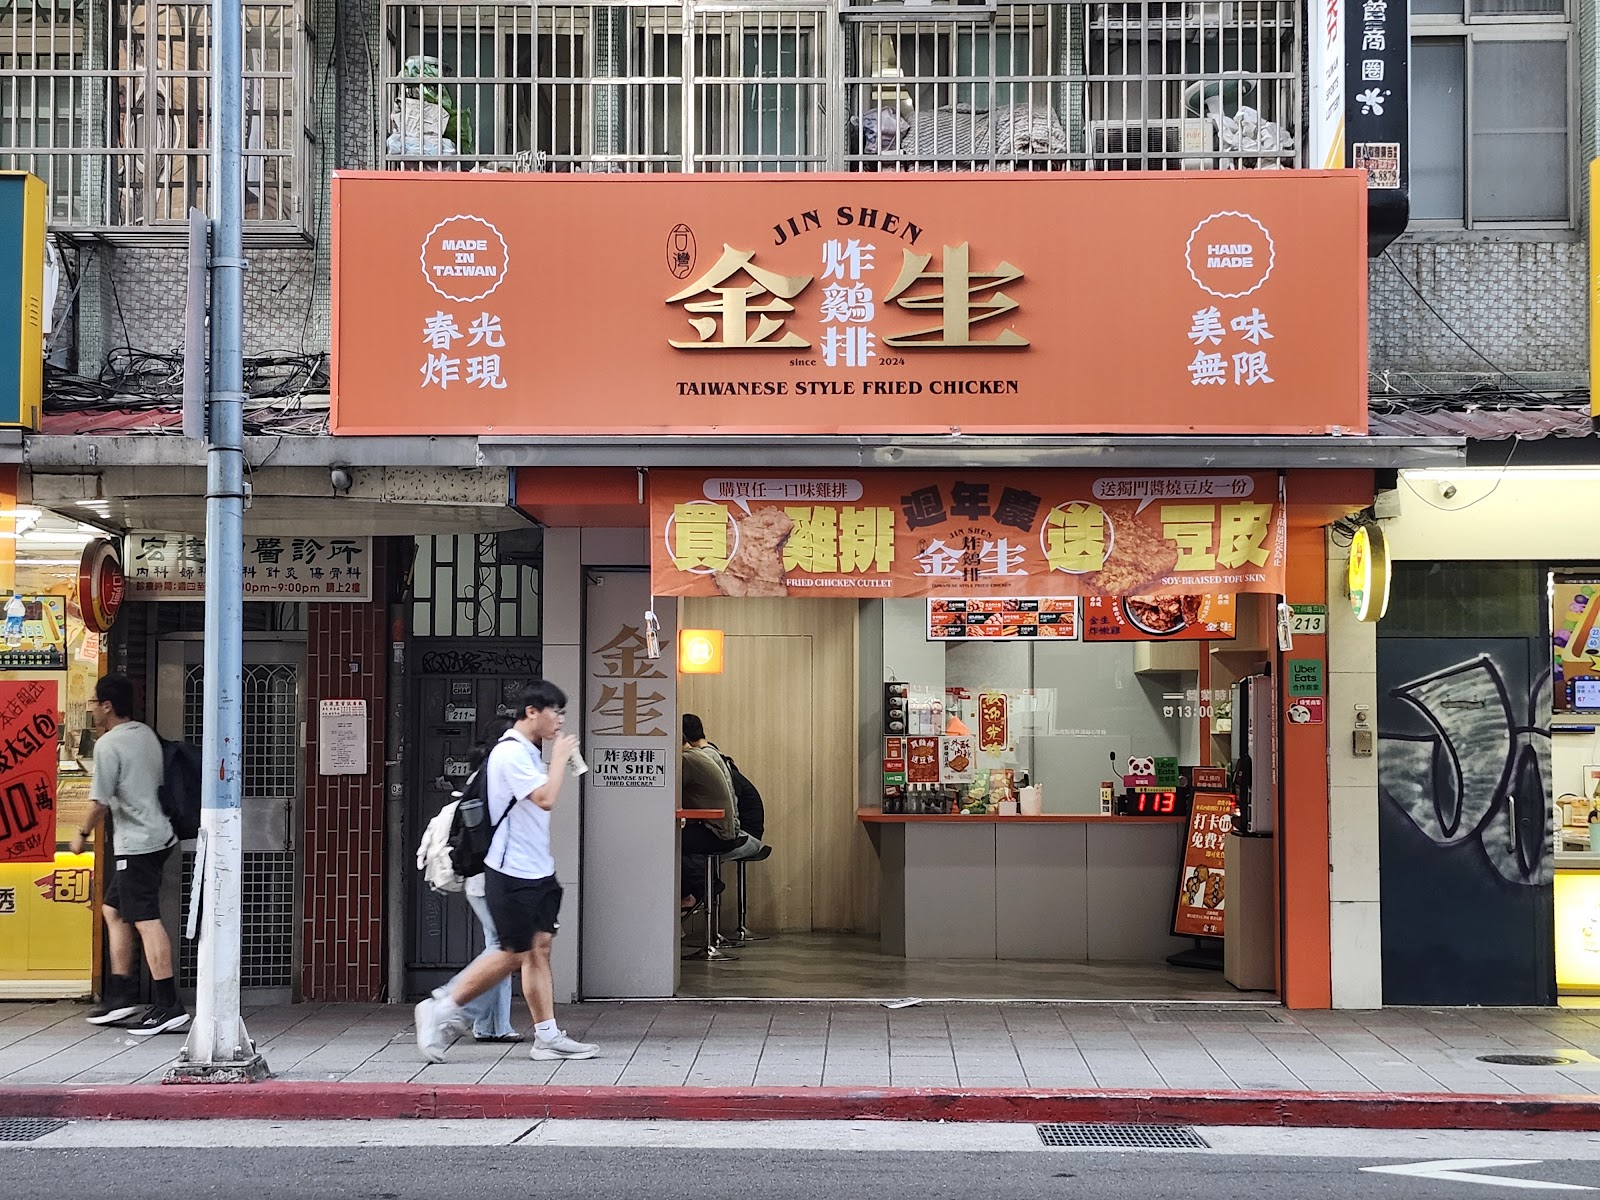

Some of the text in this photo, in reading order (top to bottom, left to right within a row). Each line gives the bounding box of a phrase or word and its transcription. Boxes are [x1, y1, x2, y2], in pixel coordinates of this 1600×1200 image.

[774, 206, 924, 246] JIN SHEN
[442, 239, 487, 251] MADE
[1207, 244, 1253, 255] HAND
[454, 252, 475, 264] IN
[1207, 256, 1254, 268] MADE
[432, 265, 497, 277] TAIWAN
[422, 310, 507, 351] 春光
[1187, 305, 1275, 346] 美味
[789, 357, 906, 367] since 2024
[1187, 349, 1275, 386] 無限
[419, 352, 508, 390] 炸現
[676, 379, 1019, 396] TAIWANESE STYLE FRIED CHICKEN
[718, 481, 849, 499] 購買任一口味雞排
[1100, 478, 1247, 497] 送獨門醬燒豆皮一份
[901, 480, 1042, 534] 週年慶
[672, 503, 895, 574] 買 雞排
[950, 527, 993, 540] JIN SHEN
[1048, 500, 1273, 573] 送 豆皮
[135, 537, 363, 565] 宏達醫診所
[912, 537, 1029, 576] 金生
[135, 566, 169, 579] 內科
[265, 566, 298, 580] 針灸
[1162, 575, 1222, 586] SOY-BRAISED
[1245, 573, 1266, 583] SKIN
[786, 578, 893, 589] FRIED CHICKEN CUTLET
[1294, 617, 1321, 630] 213
[1294, 664, 1317, 673] Uber
[592, 624, 670, 737] 金生
[1294, 673, 1317, 682] Eats
[1186, 689, 1232, 701] 營業時
[1177, 705, 1214, 718] 13:00
[594, 764, 664, 775] JIN SHEN
[1138, 792, 1175, 812] 113
[1193, 812, 1220, 830] 打卡
[53, 868, 92, 904] 刮
